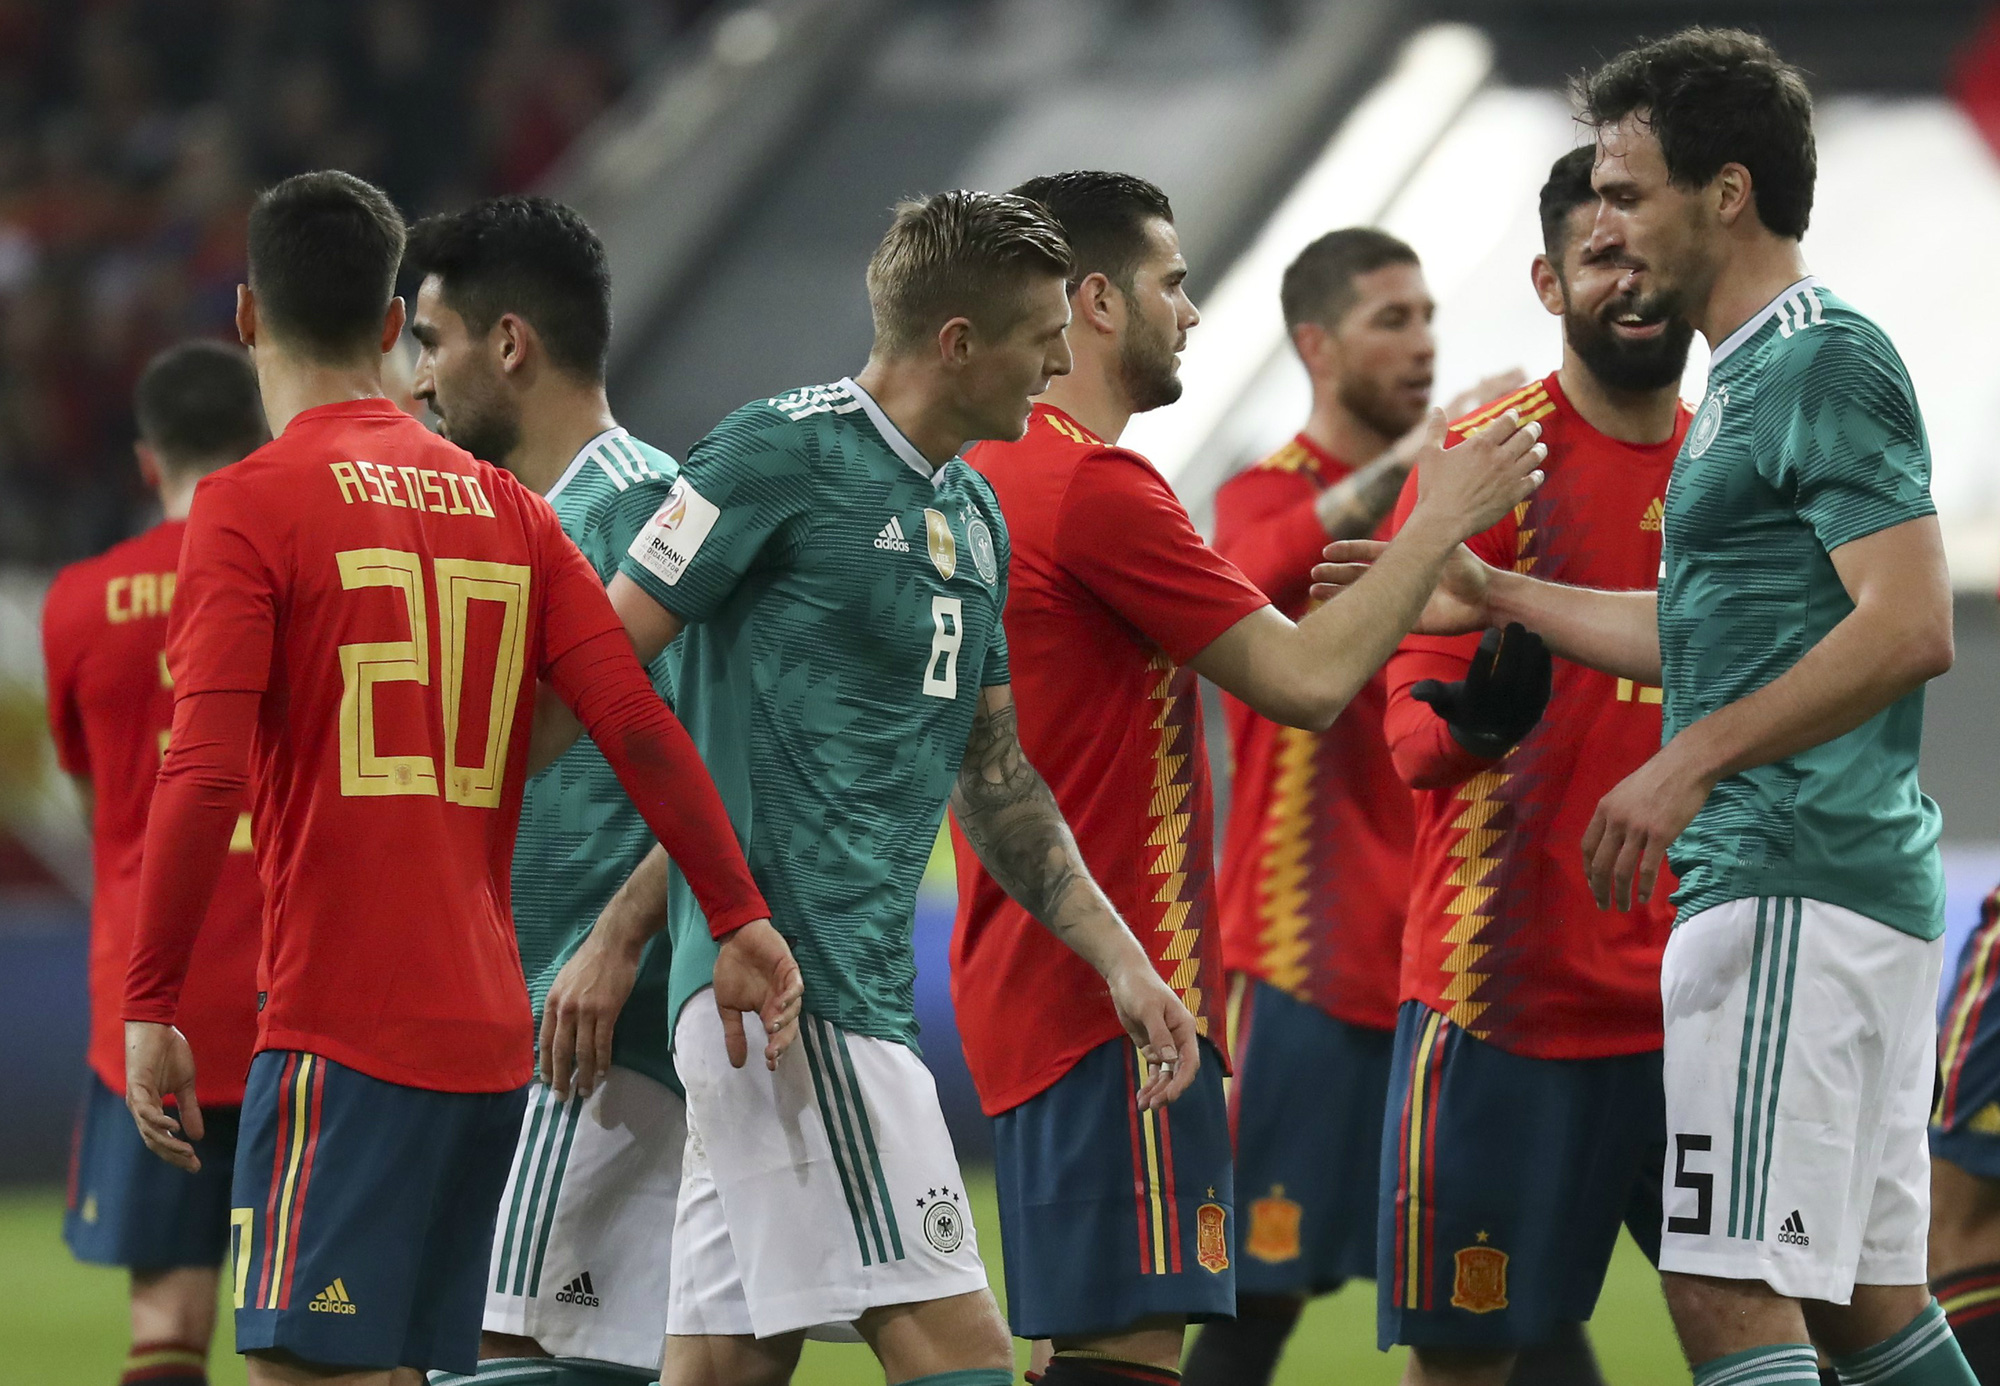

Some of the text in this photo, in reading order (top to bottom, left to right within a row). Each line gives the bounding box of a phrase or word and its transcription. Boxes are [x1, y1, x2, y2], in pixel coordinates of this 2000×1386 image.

[328, 460, 496, 519] ASENSIO
[1639, 518, 1663, 532] adid
[873, 537, 910, 553] adidas
[922, 595, 963, 700] 8
[335, 546, 531, 809] 20
[1667, 1133, 1714, 1236] 5
[1777, 1230, 1810, 1247] adidas
[308, 1299, 357, 1315] adidas
[555, 1290, 600, 1308] adidas
